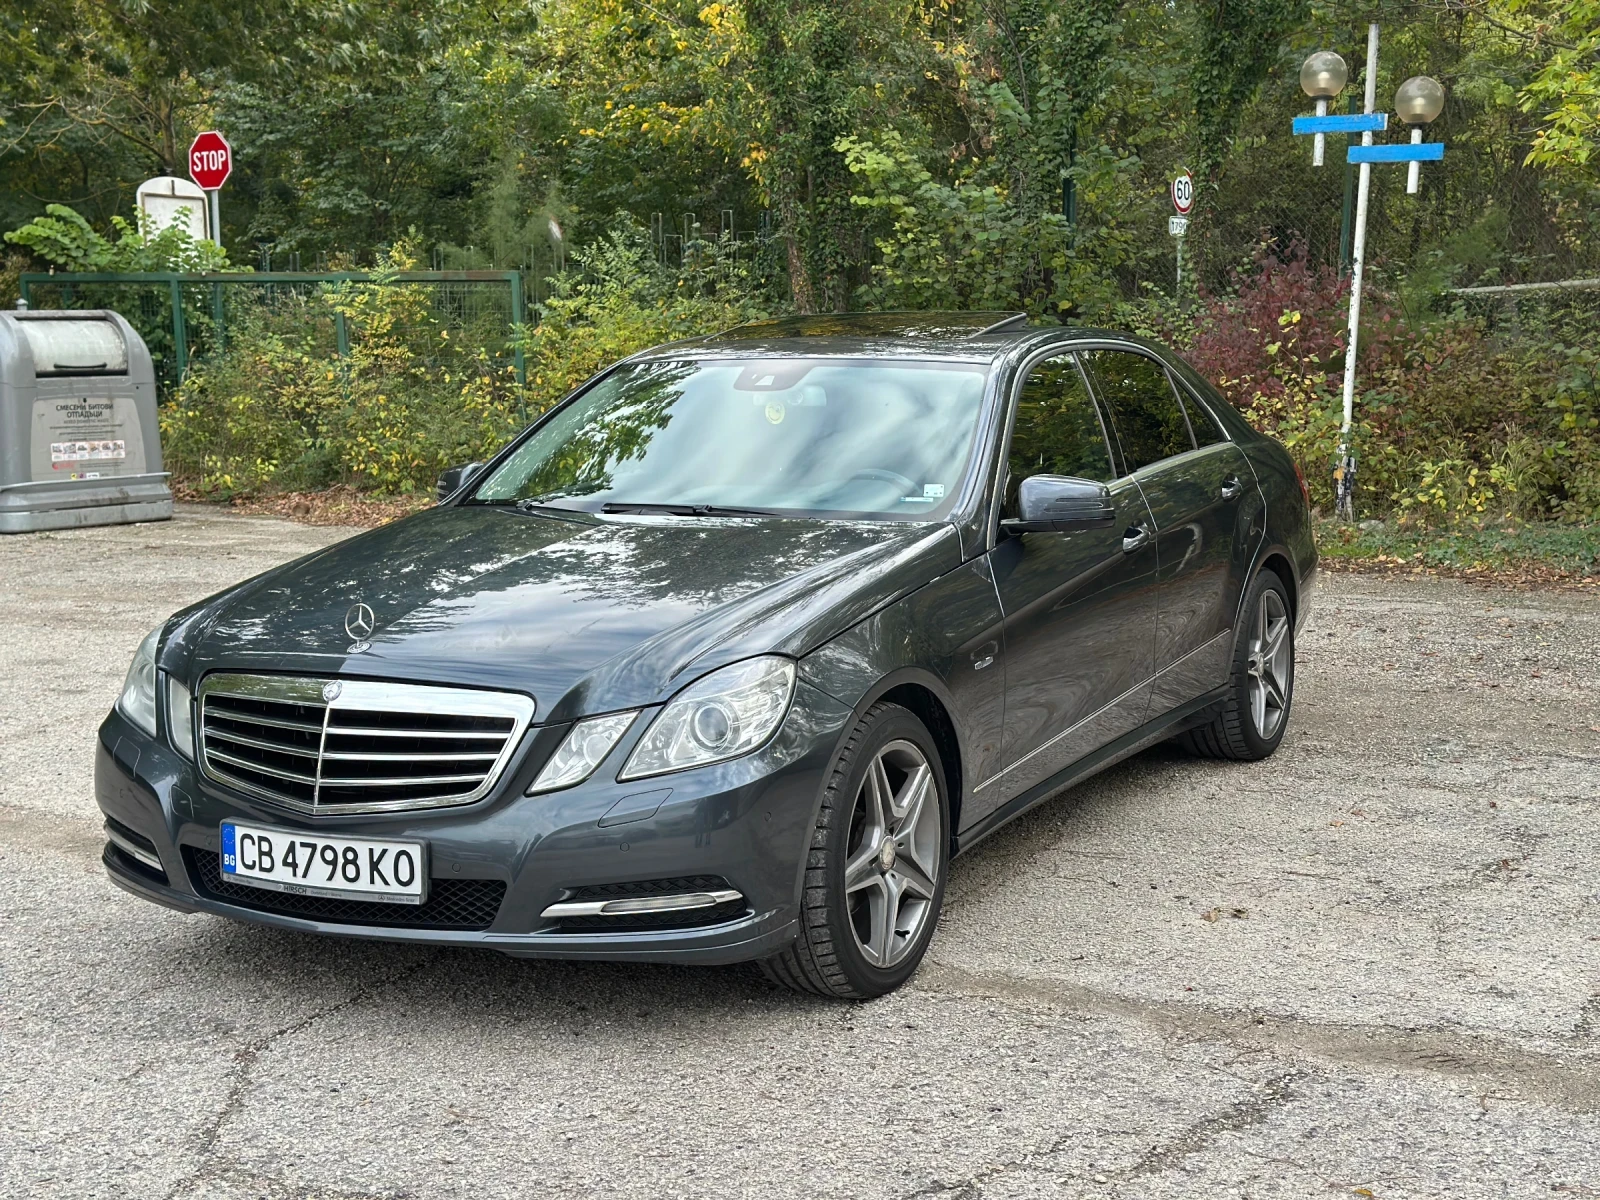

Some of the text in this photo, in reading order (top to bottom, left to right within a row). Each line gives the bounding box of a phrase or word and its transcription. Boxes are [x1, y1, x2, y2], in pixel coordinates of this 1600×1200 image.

[193, 150, 226, 172] STOP
[1177, 180, 1190, 200] 60
[67, 411, 102, 419] ОТПАДЪЦИ
[224, 854, 236, 866] BG
[240, 833, 415, 887] CB 4798 KO
[283, 885, 307, 894] HIRSCH
